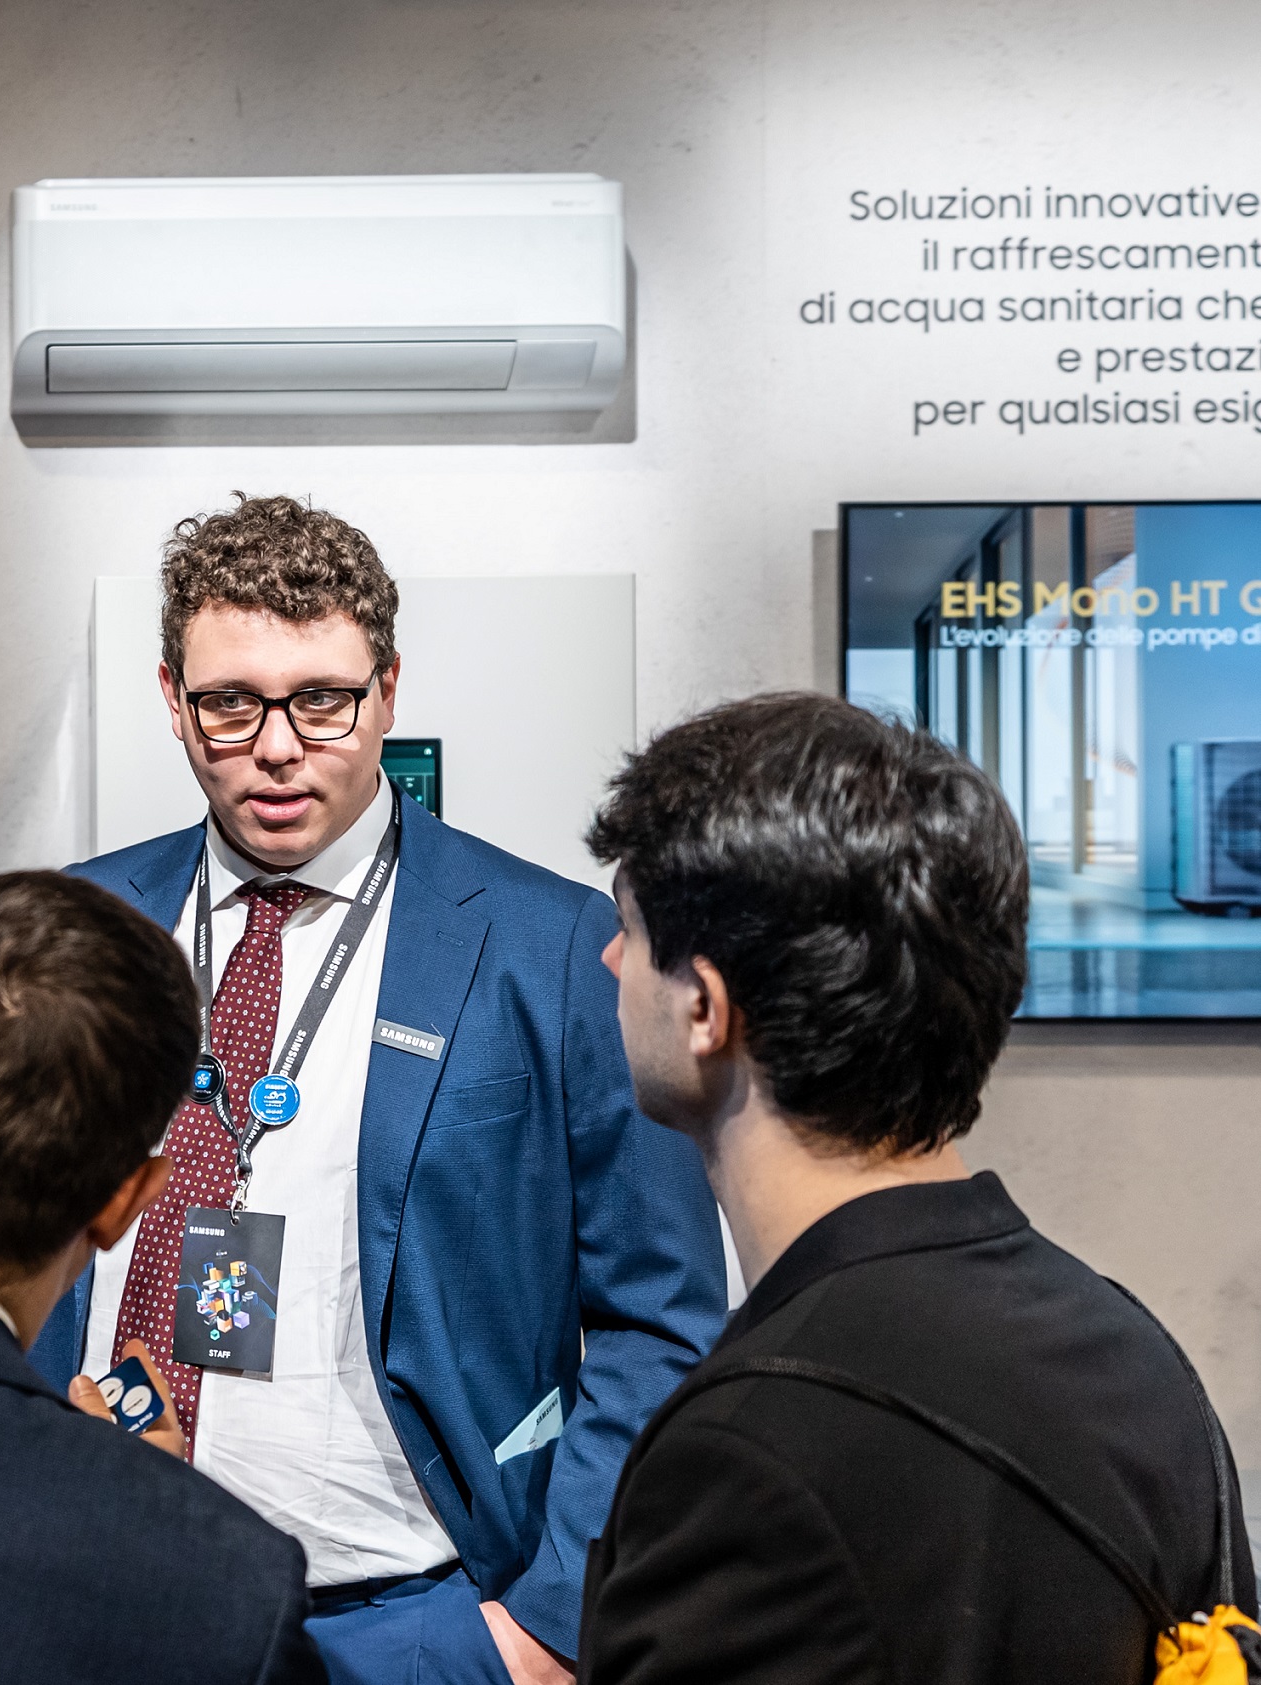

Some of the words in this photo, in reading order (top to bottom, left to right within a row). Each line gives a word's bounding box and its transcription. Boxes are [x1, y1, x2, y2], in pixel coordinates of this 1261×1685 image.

[849, 186, 1032, 221] Soluzioni
[1044, 185, 1261, 218] innovative
[922, 239, 939, 271] il
[799, 291, 836, 325] di
[848, 298, 985, 333] acqua
[998, 288, 1183, 323] sanitaria
[1056, 347, 1082, 374] e
[1095, 341, 1261, 384] prestaz
[913, 400, 986, 437] per
[998, 391, 1180, 436] qualsiasi
[942, 581, 1023, 617] EHS
[1034, 581, 1159, 617] Mono
[1171, 580, 1228, 616] HT
[1147, 627, 1238, 651] pompe
[362, 860, 388, 906] SAMSUNG
[320, 943, 348, 990] SAMSUNG
[279, 1029, 307, 1078] SAMSUNG
[380, 1027, 436, 1051] SAMSUNG
[189, 1226, 226, 1237] SAMSUNG
[208, 1349, 231, 1359] STAFF
[536, 1397, 559, 1426] SAMSUNG
